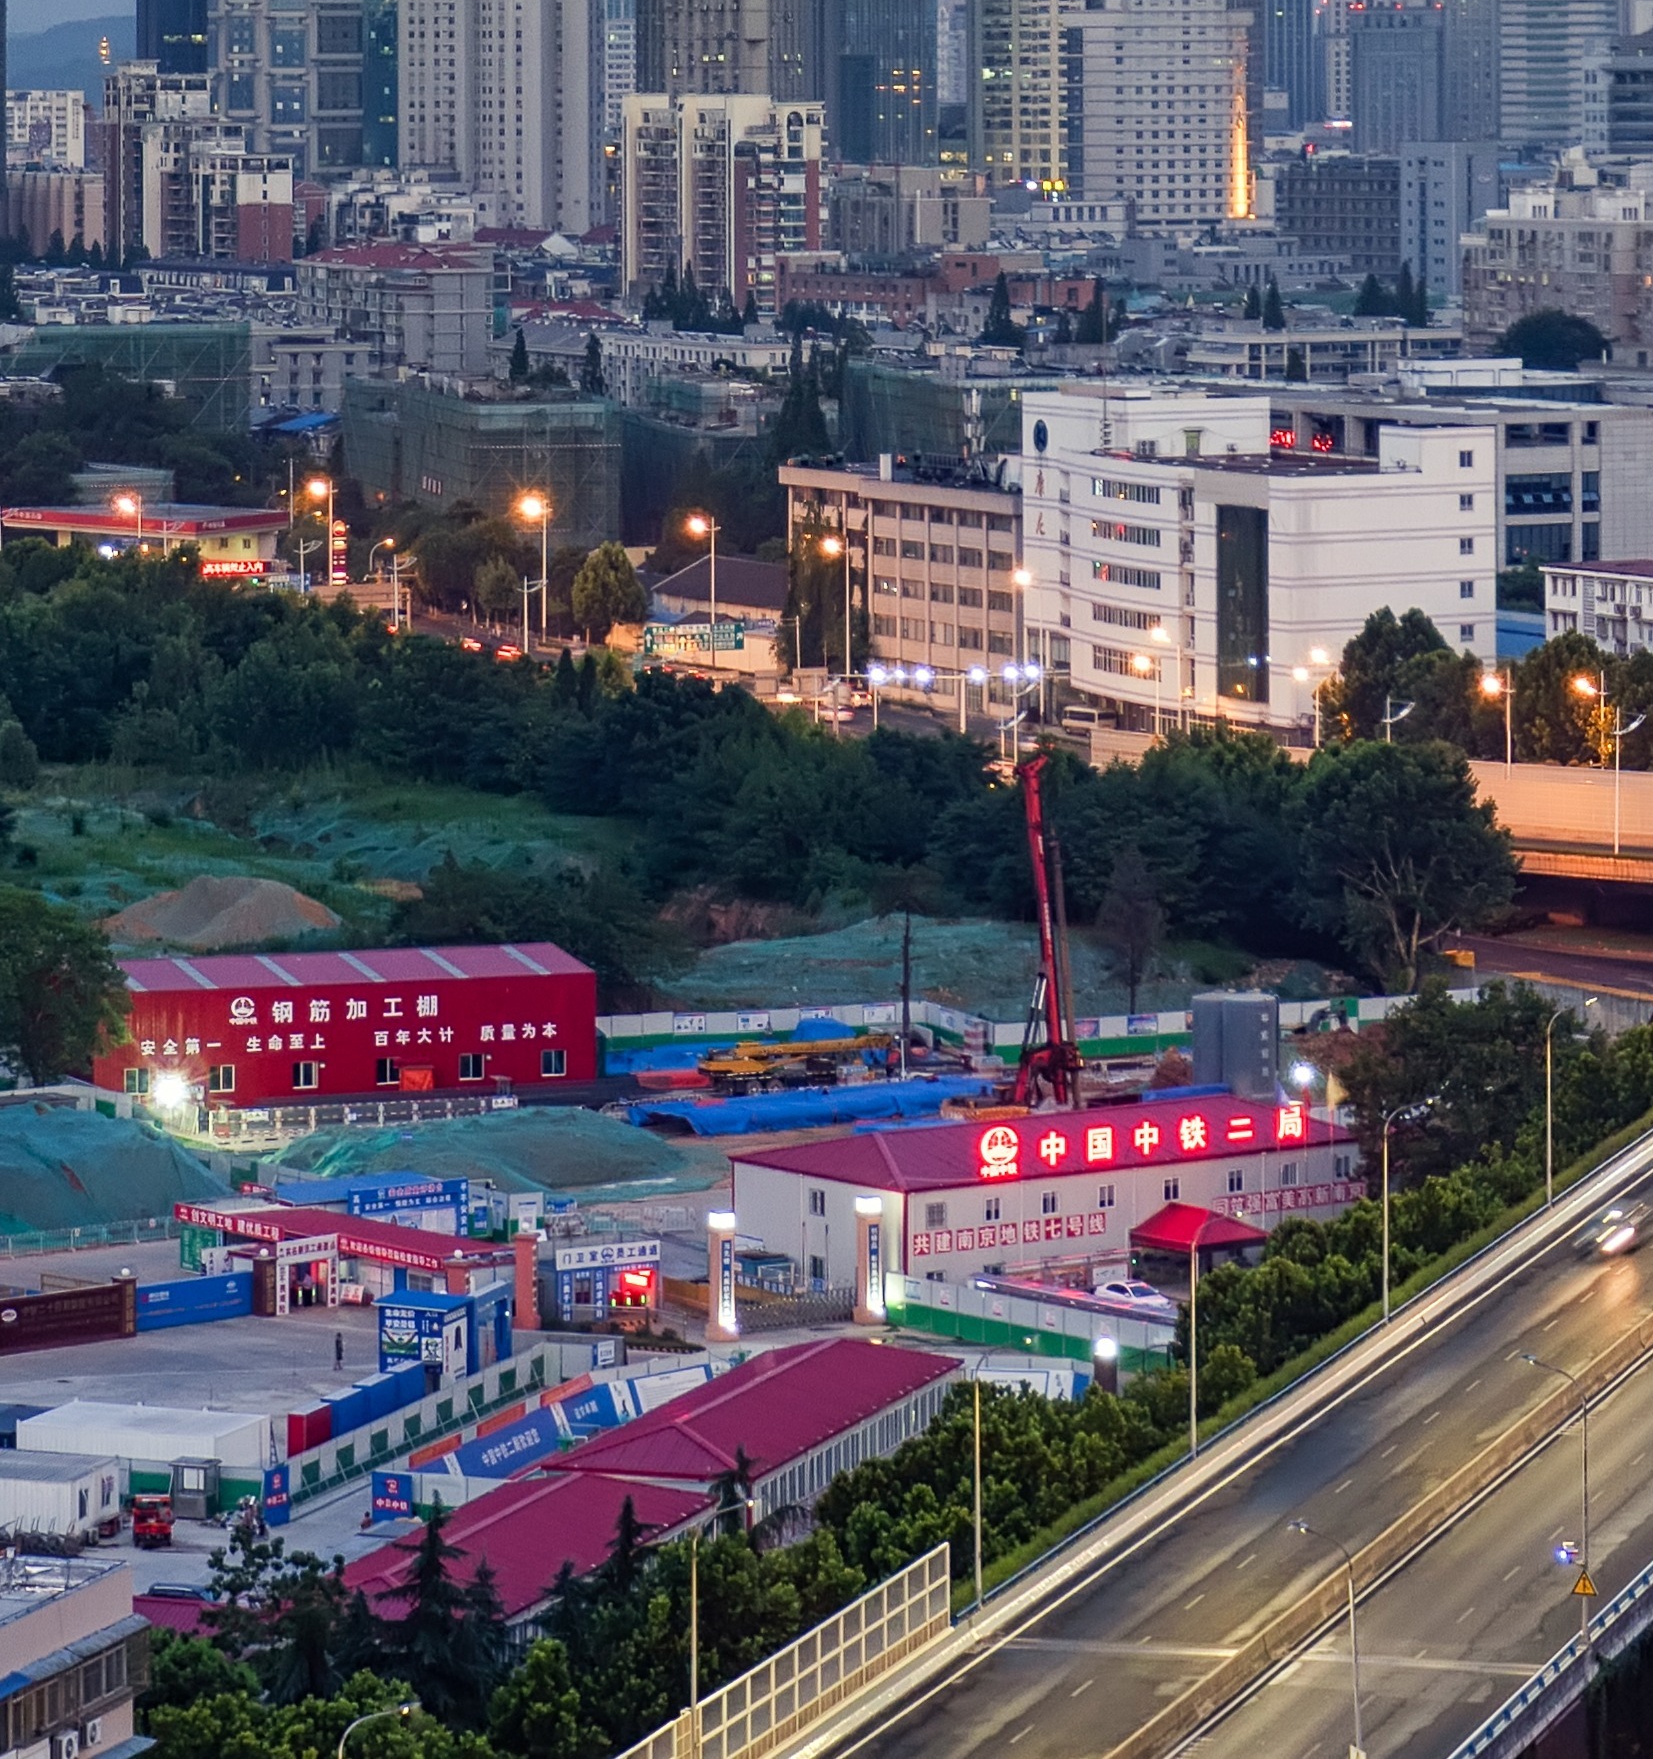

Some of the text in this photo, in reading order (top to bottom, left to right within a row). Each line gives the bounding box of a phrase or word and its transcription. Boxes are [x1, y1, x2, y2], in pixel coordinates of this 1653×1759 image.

[271, 994, 438, 1023] 钢筋加工棚
[140, 1022, 558, 1056] 安全第一 生命至上 百年大计 质量为本
[1039, 1101, 1304, 1167] 中国中铁二局
[1213, 1183, 1366, 1215] 同筑强富美高新南京
[191, 1209, 280, 1240] 创文明工地 建优质工程
[913, 1213, 1106, 1256] 共建南京地铁七号线
[563, 1244, 658, 1265] 门卫室 员工通道
